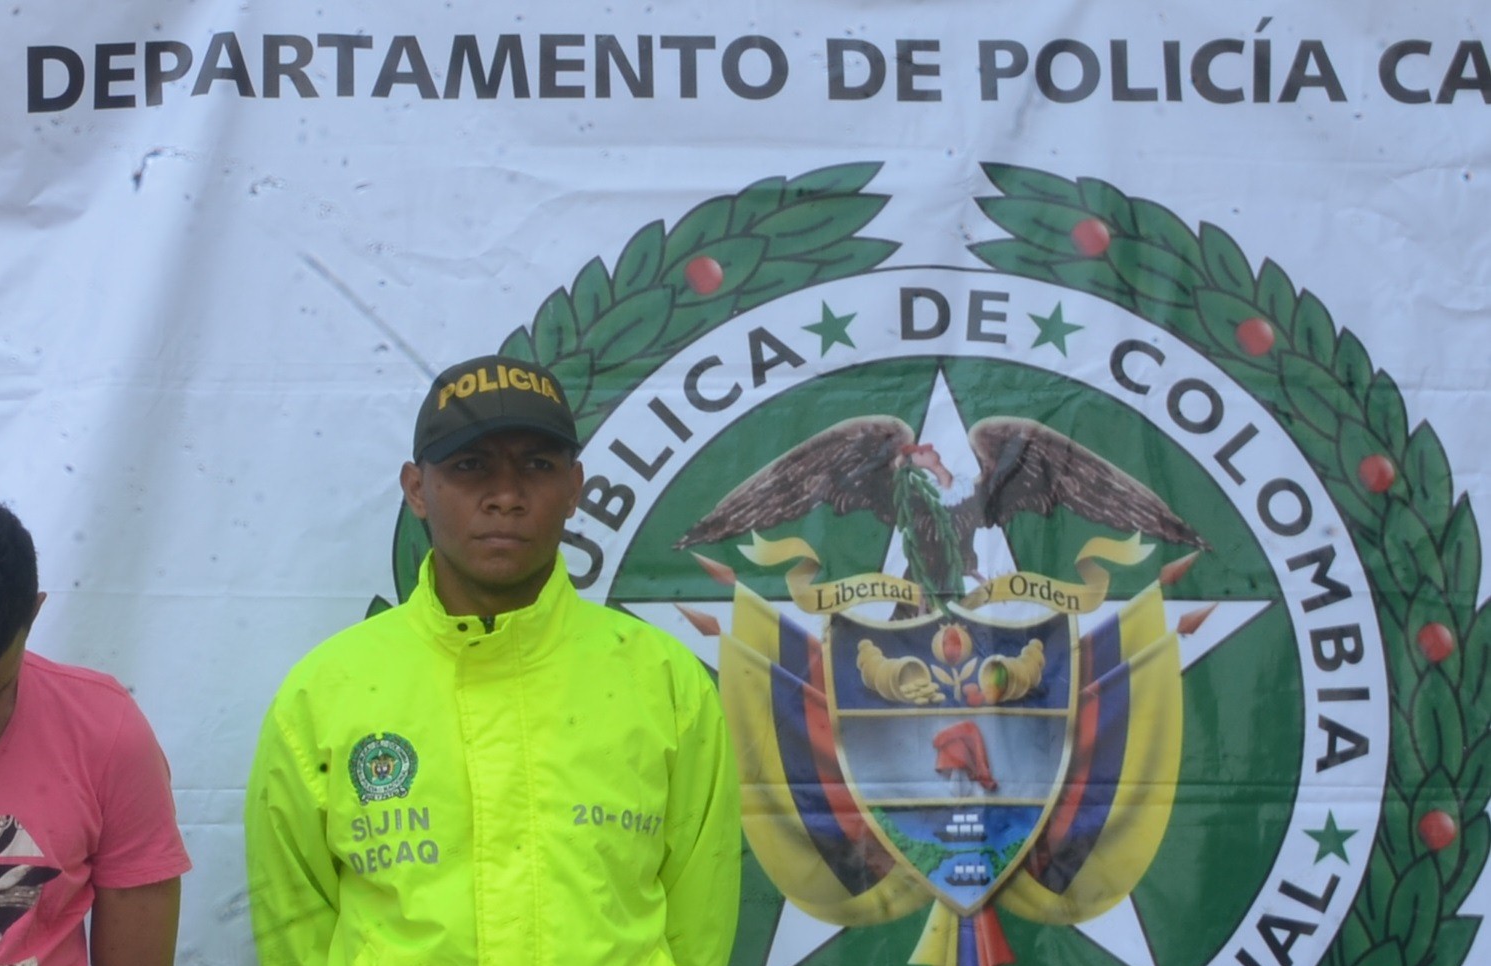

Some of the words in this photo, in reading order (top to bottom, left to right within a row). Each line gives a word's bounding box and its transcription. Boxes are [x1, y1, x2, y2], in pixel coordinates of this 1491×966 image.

[26, 31, 788, 113] DEPARTAMENTO
[826, 38, 943, 102] DE
[978, 16, 1348, 104] POLICÍA
[1378, 39, 1491, 105] CA
[438, 364, 561, 410] POLICIA
[900, 287, 1010, 344] DE
[1110, 339, 1371, 773] COLOMBIA
[815, 577, 914, 611] Libertad
[1009, 574, 1081, 611] Orden
[351, 807, 430, 842] SIJIN
[348, 839, 439, 875] DECAQ
